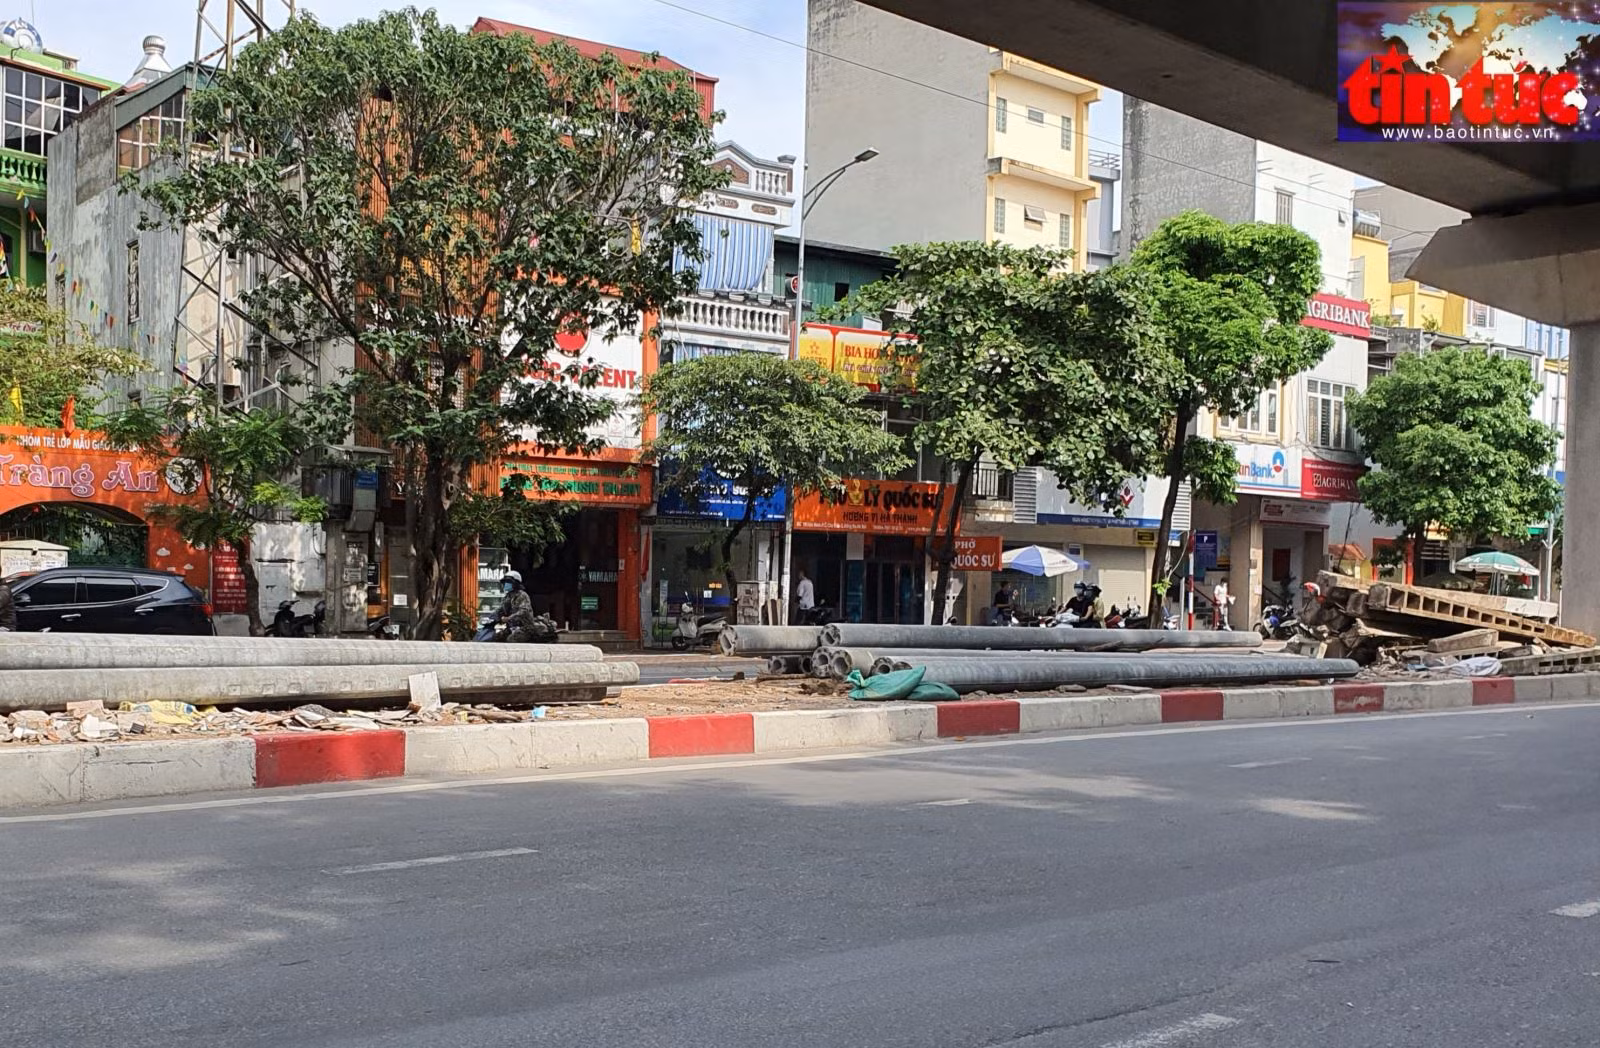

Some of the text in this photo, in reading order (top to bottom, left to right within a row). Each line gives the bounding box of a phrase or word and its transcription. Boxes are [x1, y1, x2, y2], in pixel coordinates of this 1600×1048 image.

[1307, 299, 1370, 328] AGRIBANK
[845, 345, 862, 358] BIA
[102, 461, 159, 493] An
